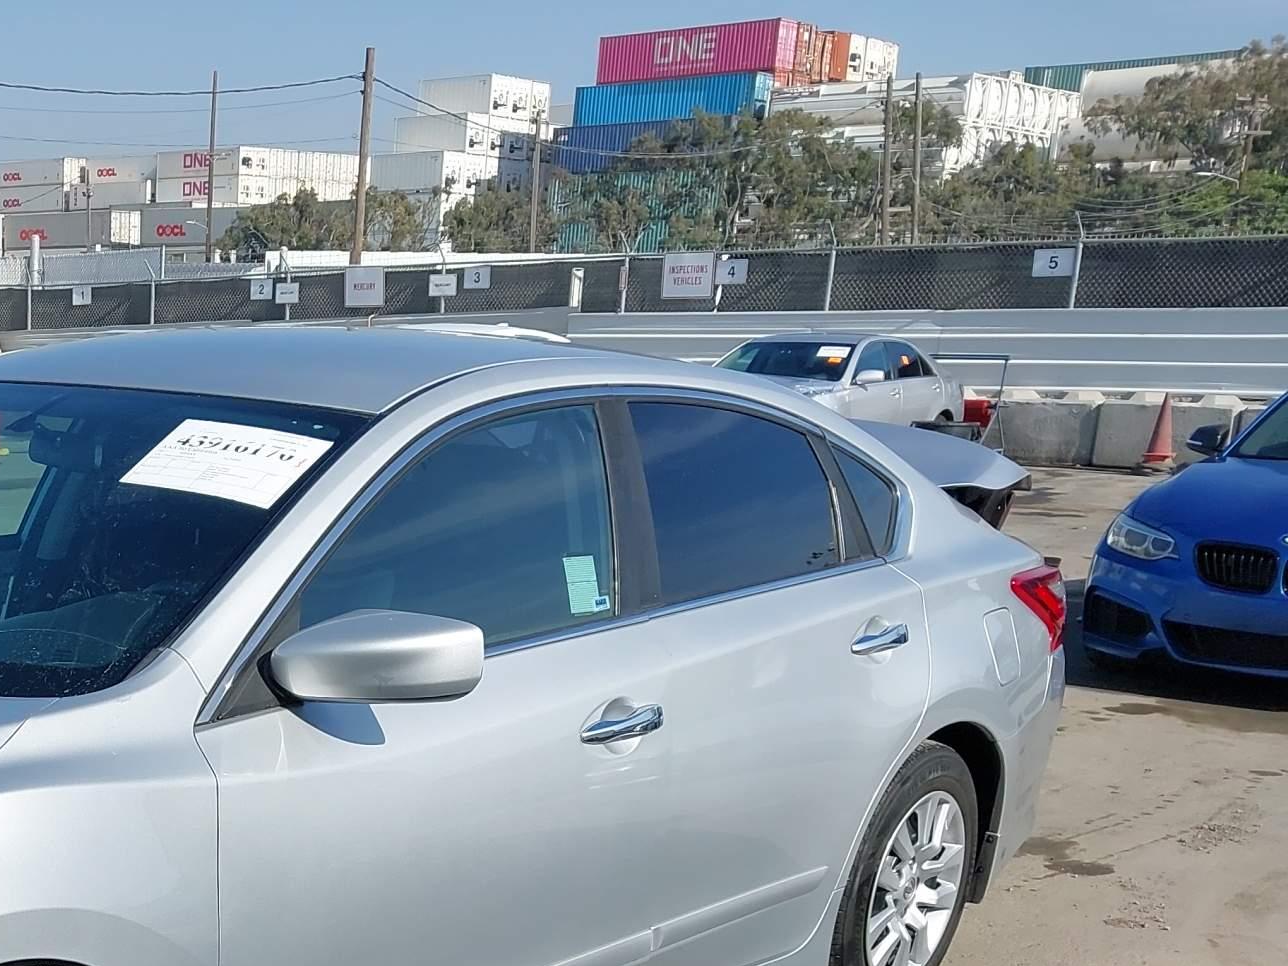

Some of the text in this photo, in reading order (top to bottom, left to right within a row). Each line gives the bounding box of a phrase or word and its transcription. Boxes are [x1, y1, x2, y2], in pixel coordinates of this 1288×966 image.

[655, 32, 716, 64] ONE
[2, 172, 22, 182] OOCL
[96, 167, 117, 178] OOCL
[2, 198, 22, 208] OOCL
[156, 224, 186, 238] OOCL
[1048, 255, 1059, 270] 5
[669, 265, 708, 275] INSPECTIONS
[727, 265, 736, 279] 4
[473, 271, 481, 284] 3
[673, 275, 702, 286] VEHICLES
[258, 283, 265, 295] 2
[80, 290, 86, 300] 1
